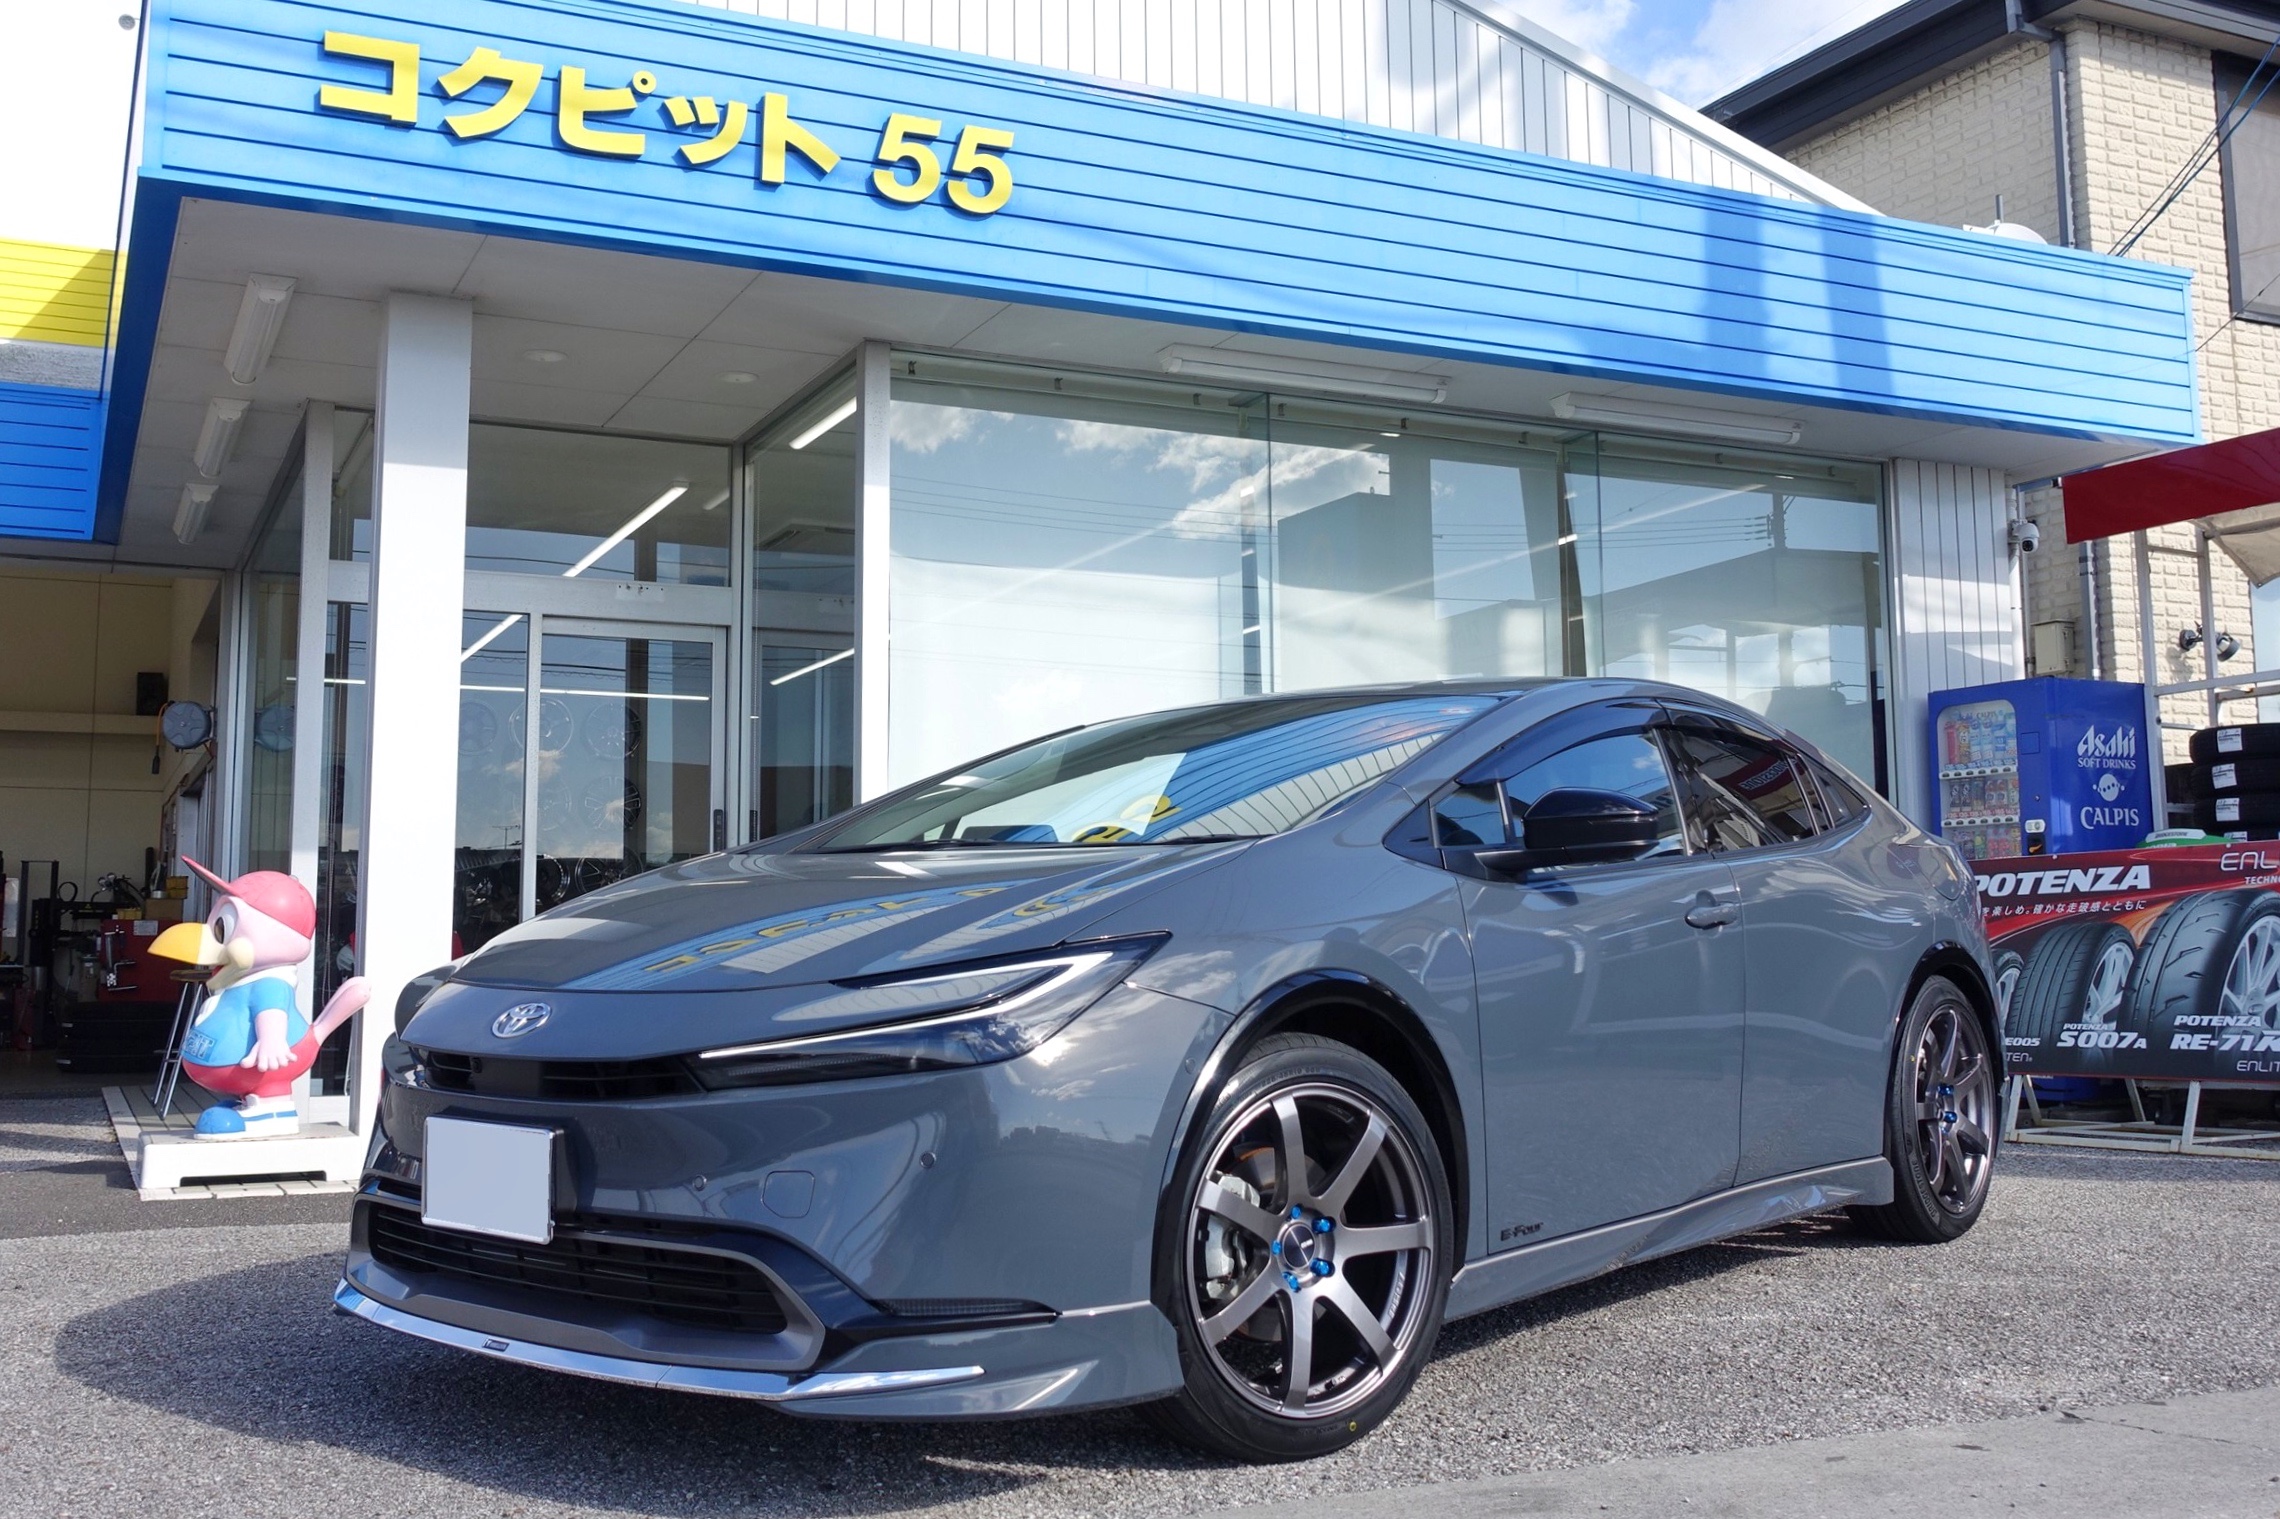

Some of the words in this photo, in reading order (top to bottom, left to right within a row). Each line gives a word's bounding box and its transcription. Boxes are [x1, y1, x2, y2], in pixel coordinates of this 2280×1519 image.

[320, 30, 842, 184] コクピット
[871, 114, 1014, 215] 55
[2077, 724, 2136, 758] Asahi
[2077, 757, 2101, 768] SOFT
[2102, 758, 2136, 770] DRINKS
[2080, 806, 2140, 830] CALPIS
[2244, 875, 2280, 885] TECHN
[2063, 1023, 2109, 1031] POTENZA
[2173, 1015, 2262, 1027] POTENZA
[2056, 1030, 2147, 1049] S007A
